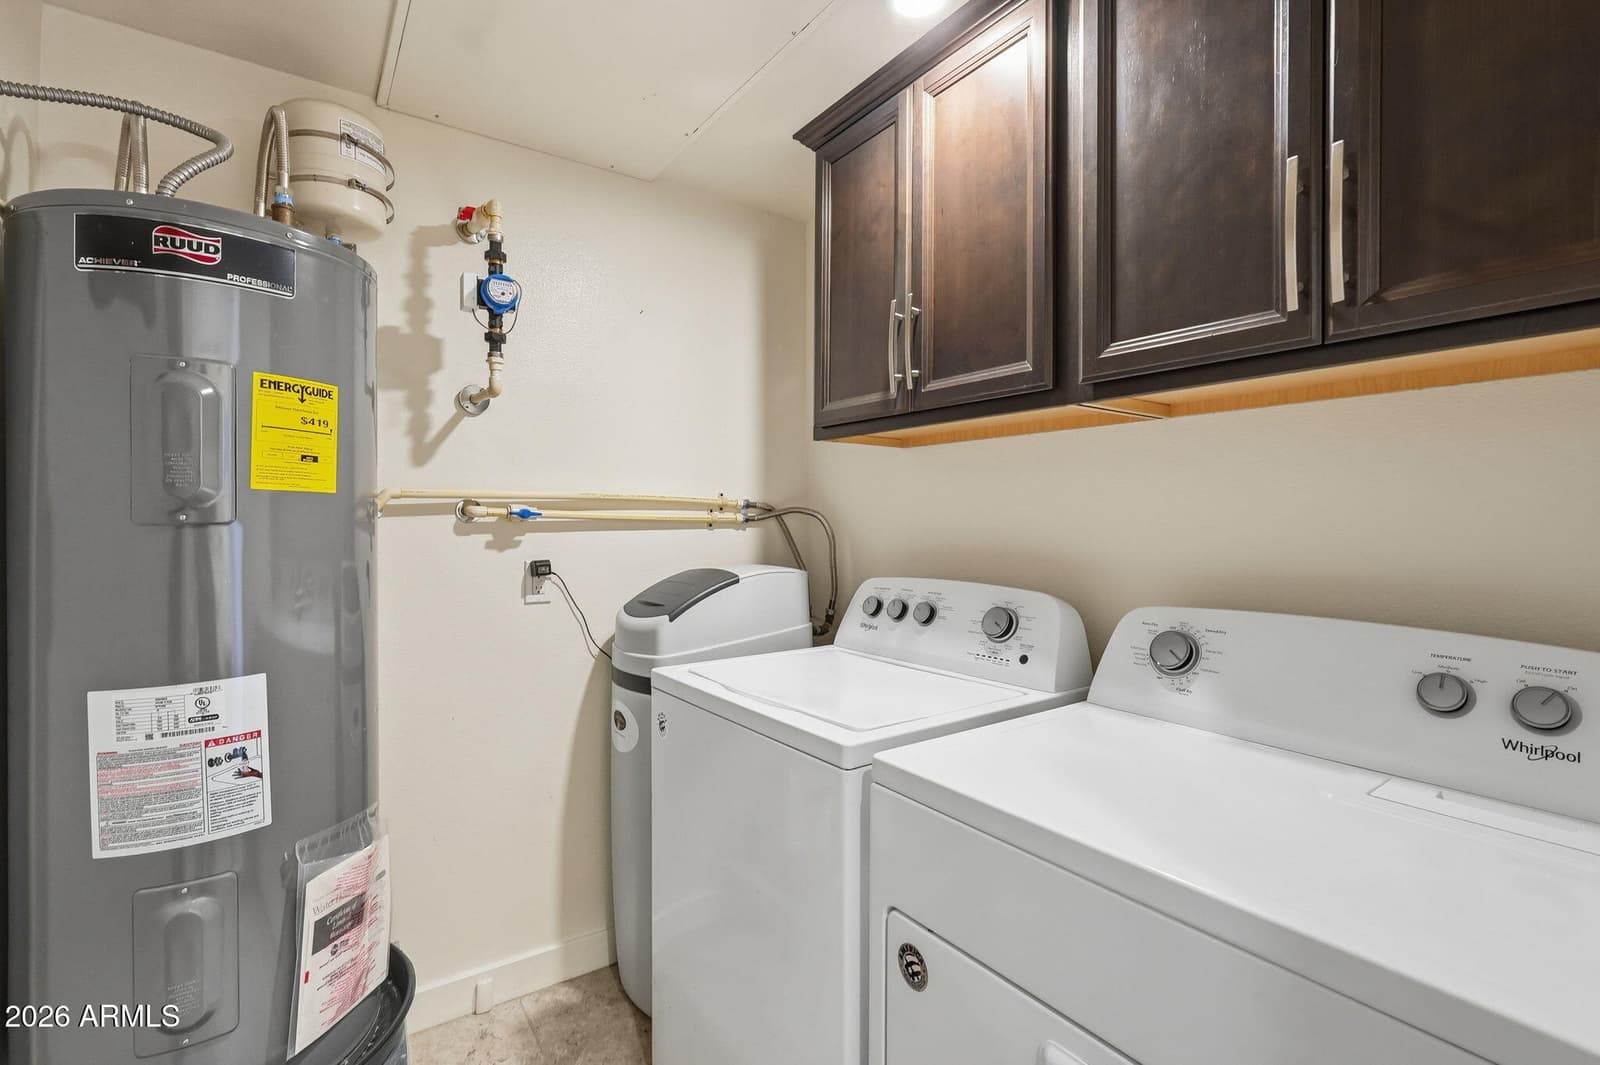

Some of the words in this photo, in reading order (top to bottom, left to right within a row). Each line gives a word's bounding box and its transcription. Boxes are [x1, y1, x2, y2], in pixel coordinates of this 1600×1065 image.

[153, 235, 221, 255] RUUD
[78, 256, 139, 267] ACHIEVER
[226, 273, 292, 292] PROFESSIONAL
[259, 378, 334, 401] ENERGYGUIDE
[300, 416, 329, 428] $419
[218, 731, 259, 746] DANGER
[1501, 737, 1582, 764] Whirlpool
